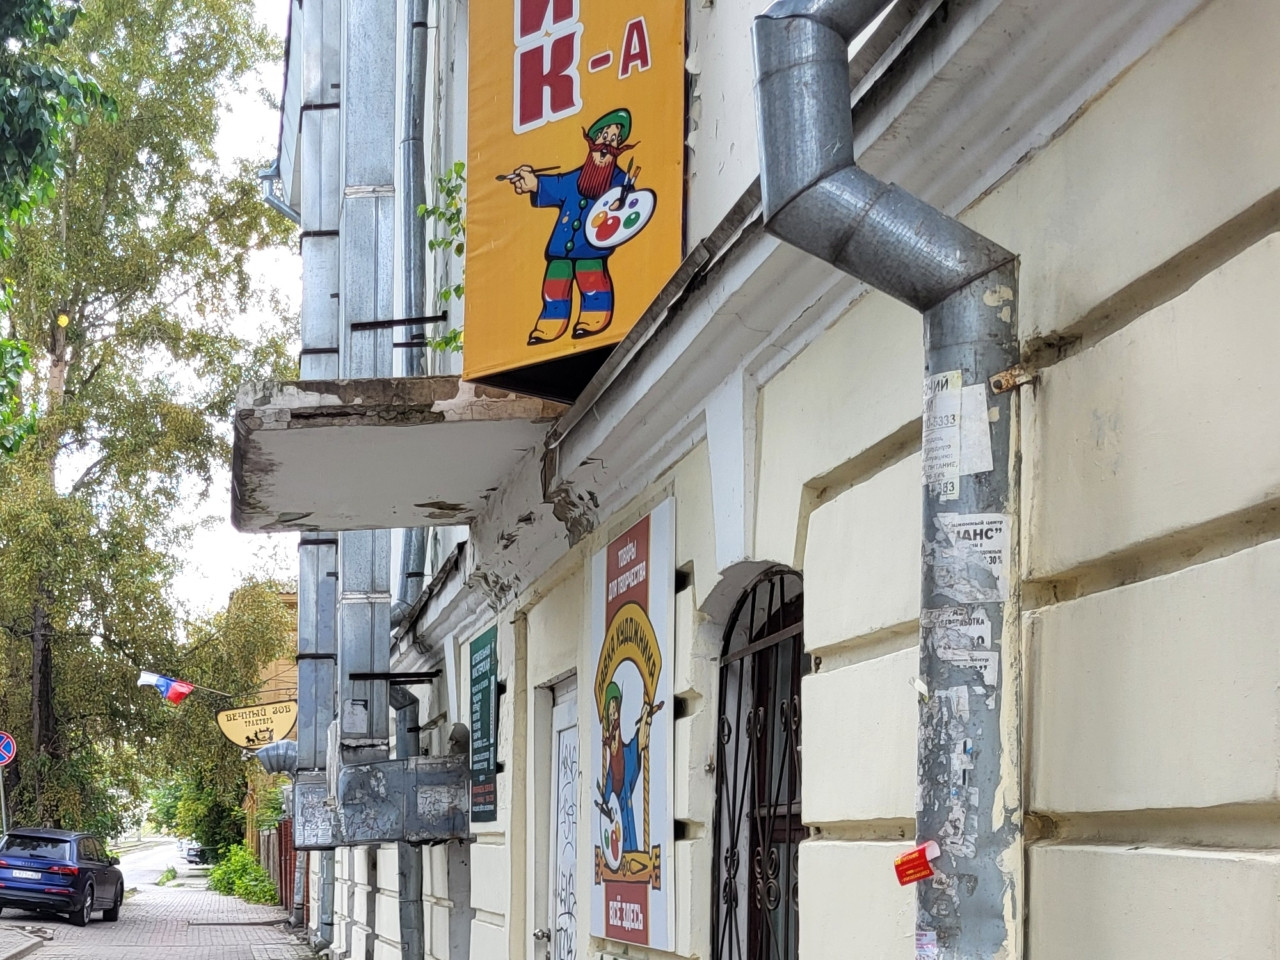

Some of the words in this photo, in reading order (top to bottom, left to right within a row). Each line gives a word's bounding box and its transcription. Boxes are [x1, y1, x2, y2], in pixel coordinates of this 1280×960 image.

[618, 538, 637, 568] ТОВАРЫ
[608, 579, 618, 603] ДЛЯ
[618, 561, 646, 595] ТВОРЧЕСТВА
[616, 617, 657, 687] ХУДОЖНИКА
[225, 707, 267, 722] ВЕЧНЫЙ
[272, 704, 291, 715] ЗОВ
[609, 895, 621, 926] ВСЁ
[622, 902, 643, 931] ЗДЕСЬ
